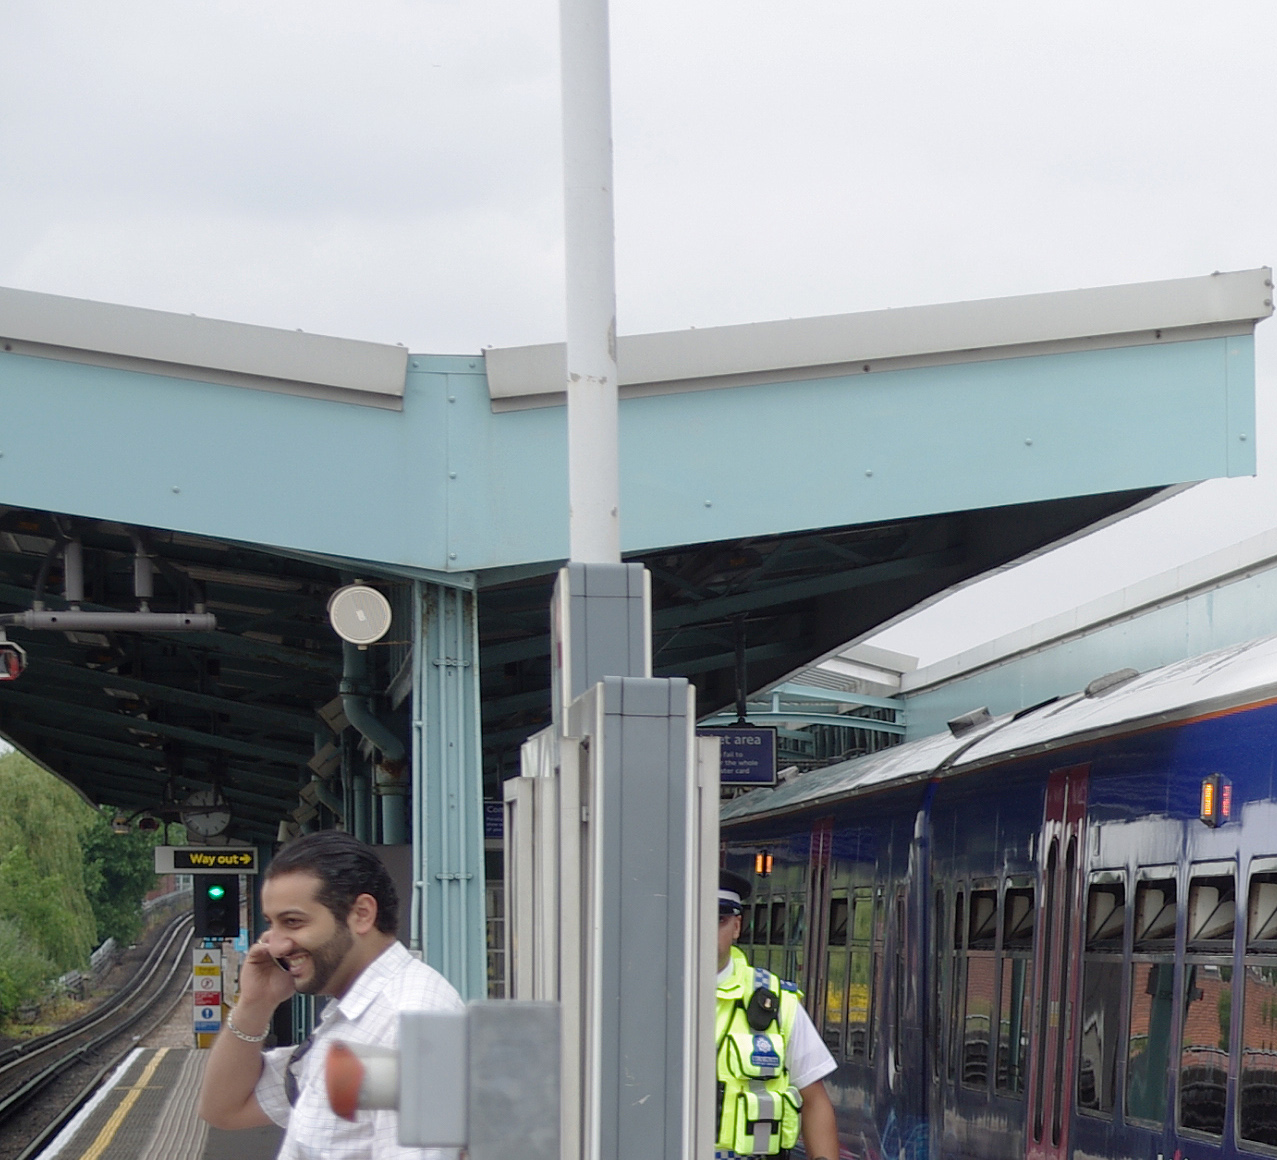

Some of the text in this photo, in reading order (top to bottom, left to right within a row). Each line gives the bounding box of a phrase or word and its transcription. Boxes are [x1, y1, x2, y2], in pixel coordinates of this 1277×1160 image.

[734, 735, 762, 745] area
[189, 853, 239, 867] Way out
